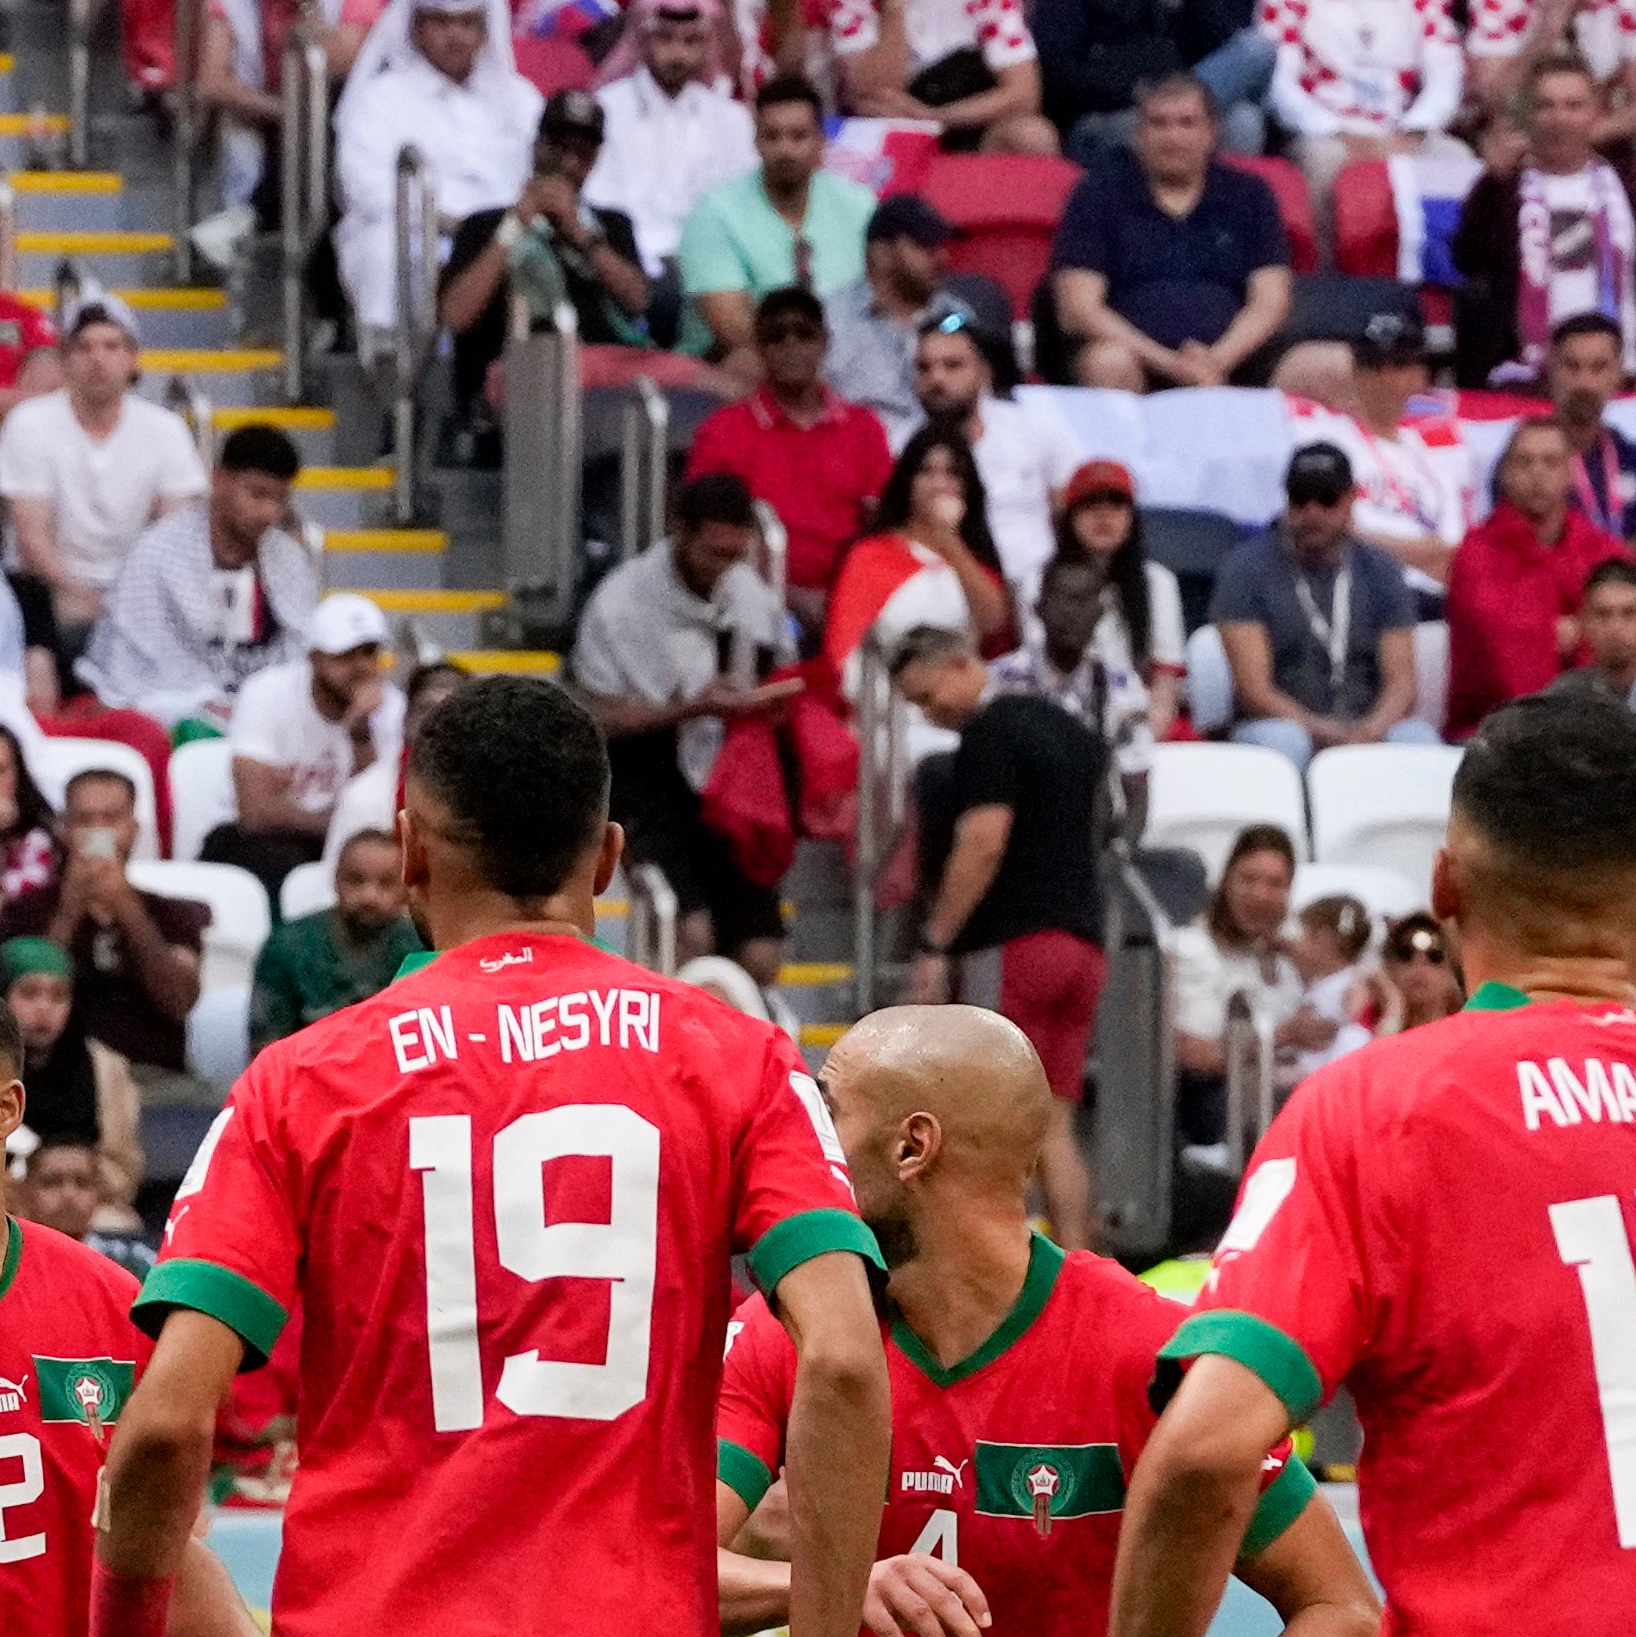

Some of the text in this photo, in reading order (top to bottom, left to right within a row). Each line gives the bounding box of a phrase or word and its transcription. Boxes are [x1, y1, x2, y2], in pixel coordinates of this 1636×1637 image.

[389, 1005, 458, 1074] EN
[498, 988, 661, 1063] NESYRI
[408, 1104, 660, 1432] 19
[901, 1471, 954, 1495] PUMA
